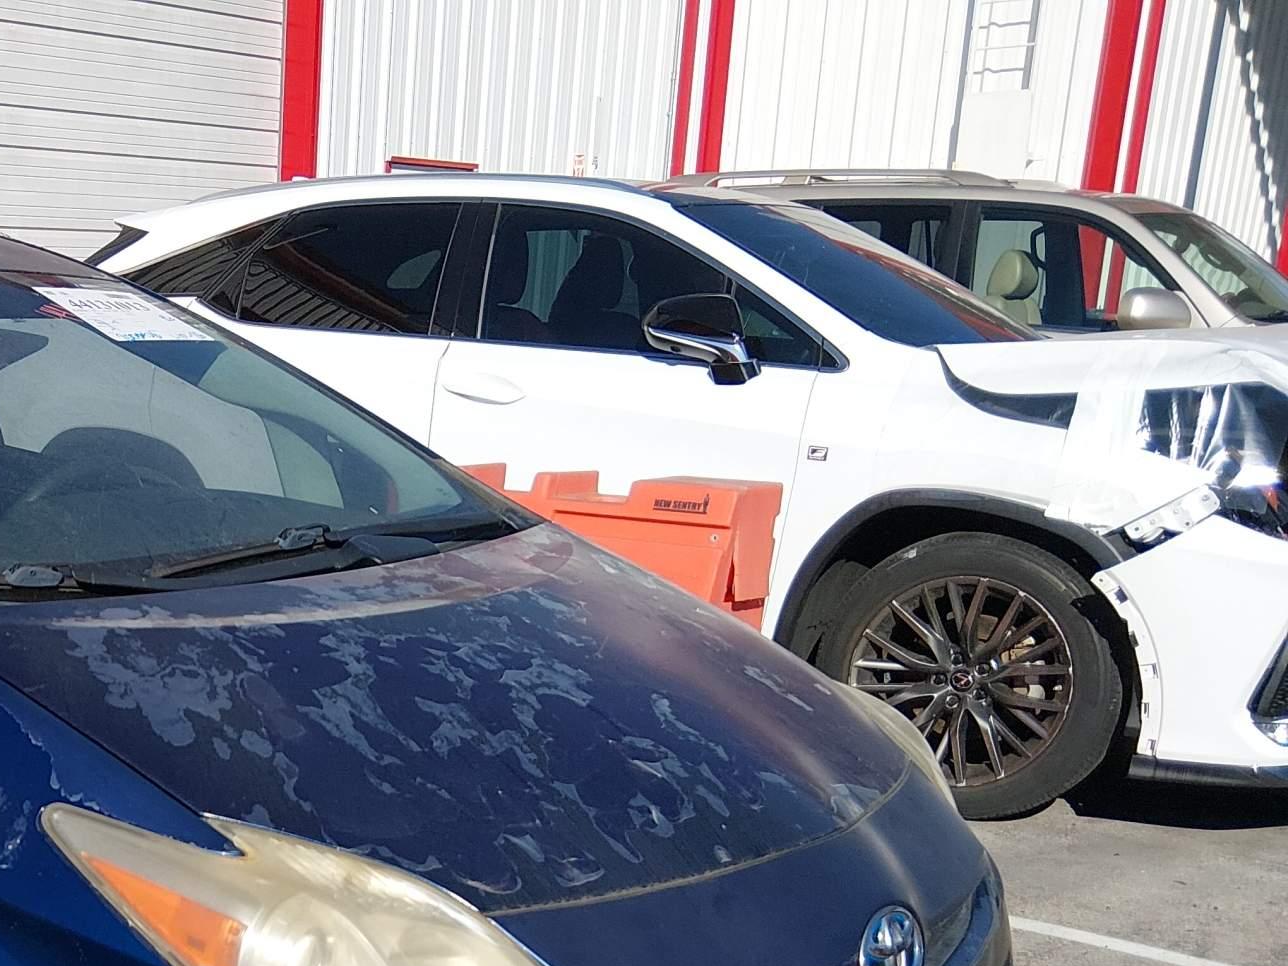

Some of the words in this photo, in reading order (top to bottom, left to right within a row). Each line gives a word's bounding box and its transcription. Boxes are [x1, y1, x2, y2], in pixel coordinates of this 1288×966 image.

[68, 298, 151, 312] 44131013
[653, 498, 672, 508] NEW
[672, 500, 703, 511] SENTRY
